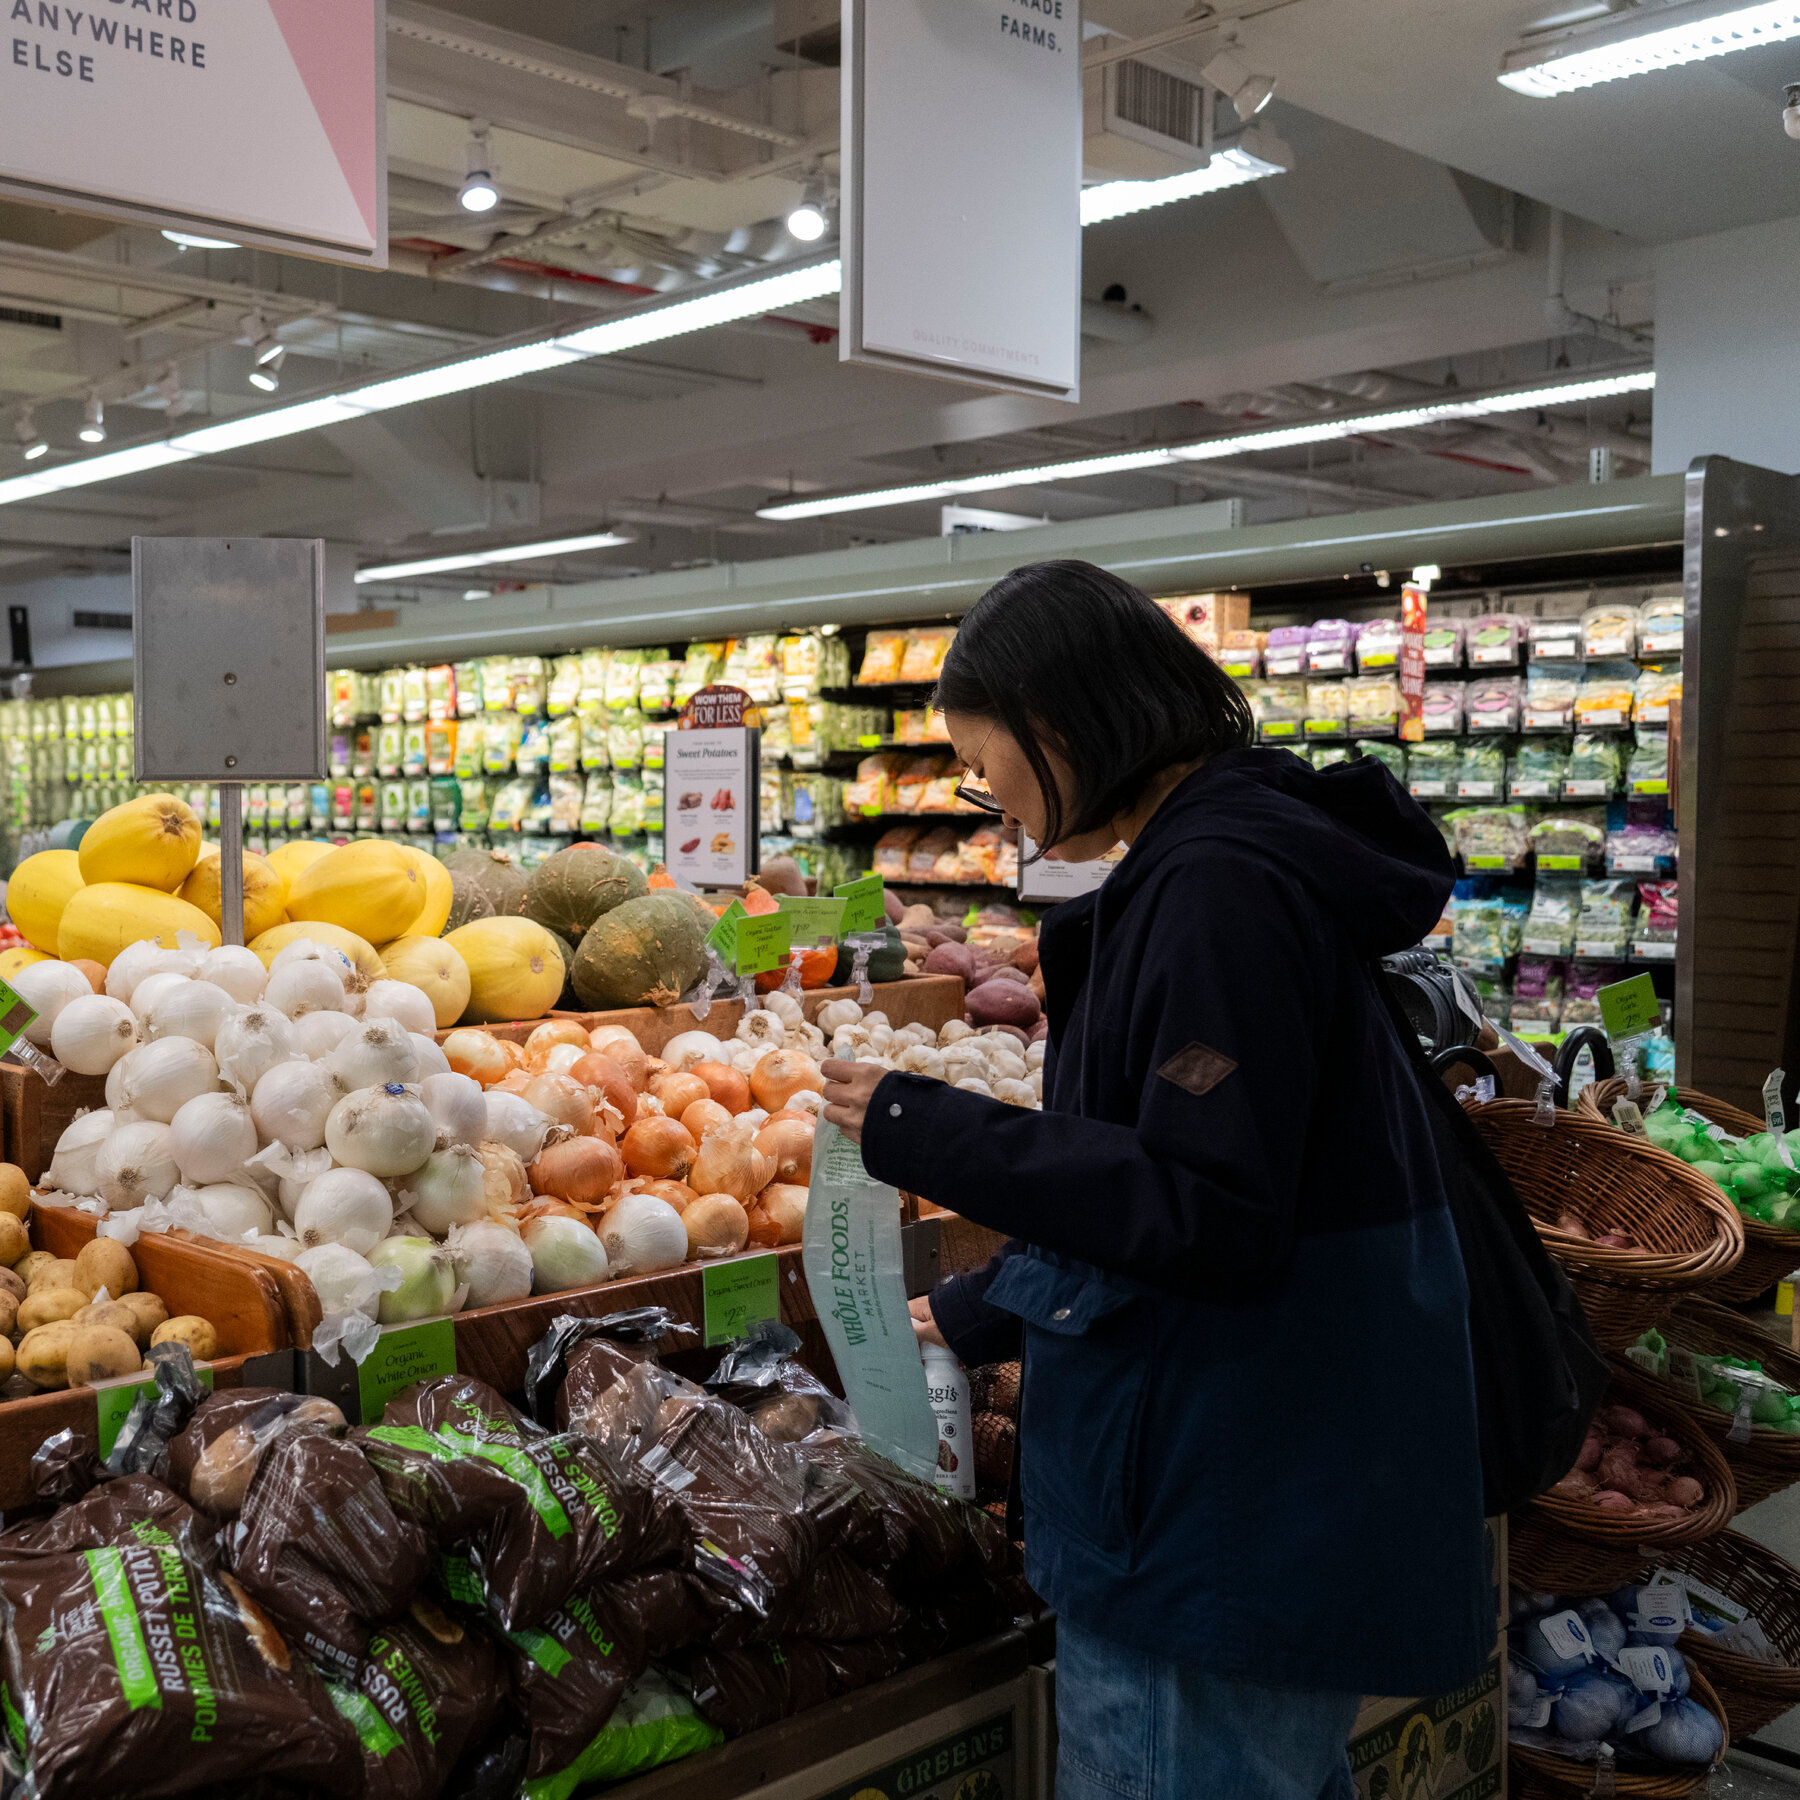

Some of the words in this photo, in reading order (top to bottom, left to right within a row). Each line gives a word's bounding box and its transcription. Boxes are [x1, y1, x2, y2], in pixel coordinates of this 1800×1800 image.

[11, 0, 206, 69] ANYWHERE
[1001, 15, 1062, 53] FARMS.
[13, 38, 94, 83] ELSE
[912, 329, 958, 348] QUALITY
[961, 340, 1040, 365] COMMITMENTS
[694, 706, 715, 724] FOR
[716, 705, 741, 723] LESS
[695, 694, 717, 705] WOW
[717, 692, 742, 704] THEM
[676, 748, 700, 759] Sweet
[701, 747, 738, 758] Potatoes
[831, 1199, 850, 1281] FOODS
[854, 1251, 875, 1317] MARKET
[832, 1286, 868, 1346] WHOLE
[375, 1369, 406, 1385] White
[406, 1362, 439, 1378] Onion
[385, 1350, 426, 1368] Organic
[564, 1463, 618, 1539] POMMES
[112, 1614, 145, 1681] ORGANIC
[172, 1612, 198, 1639] DE
[143, 1610, 188, 1692] RUSSET
[180, 1645, 218, 1742] POMMES
[1435, 1668, 1497, 1718] GREENS
[896, 1726, 1005, 1793] GREENS
